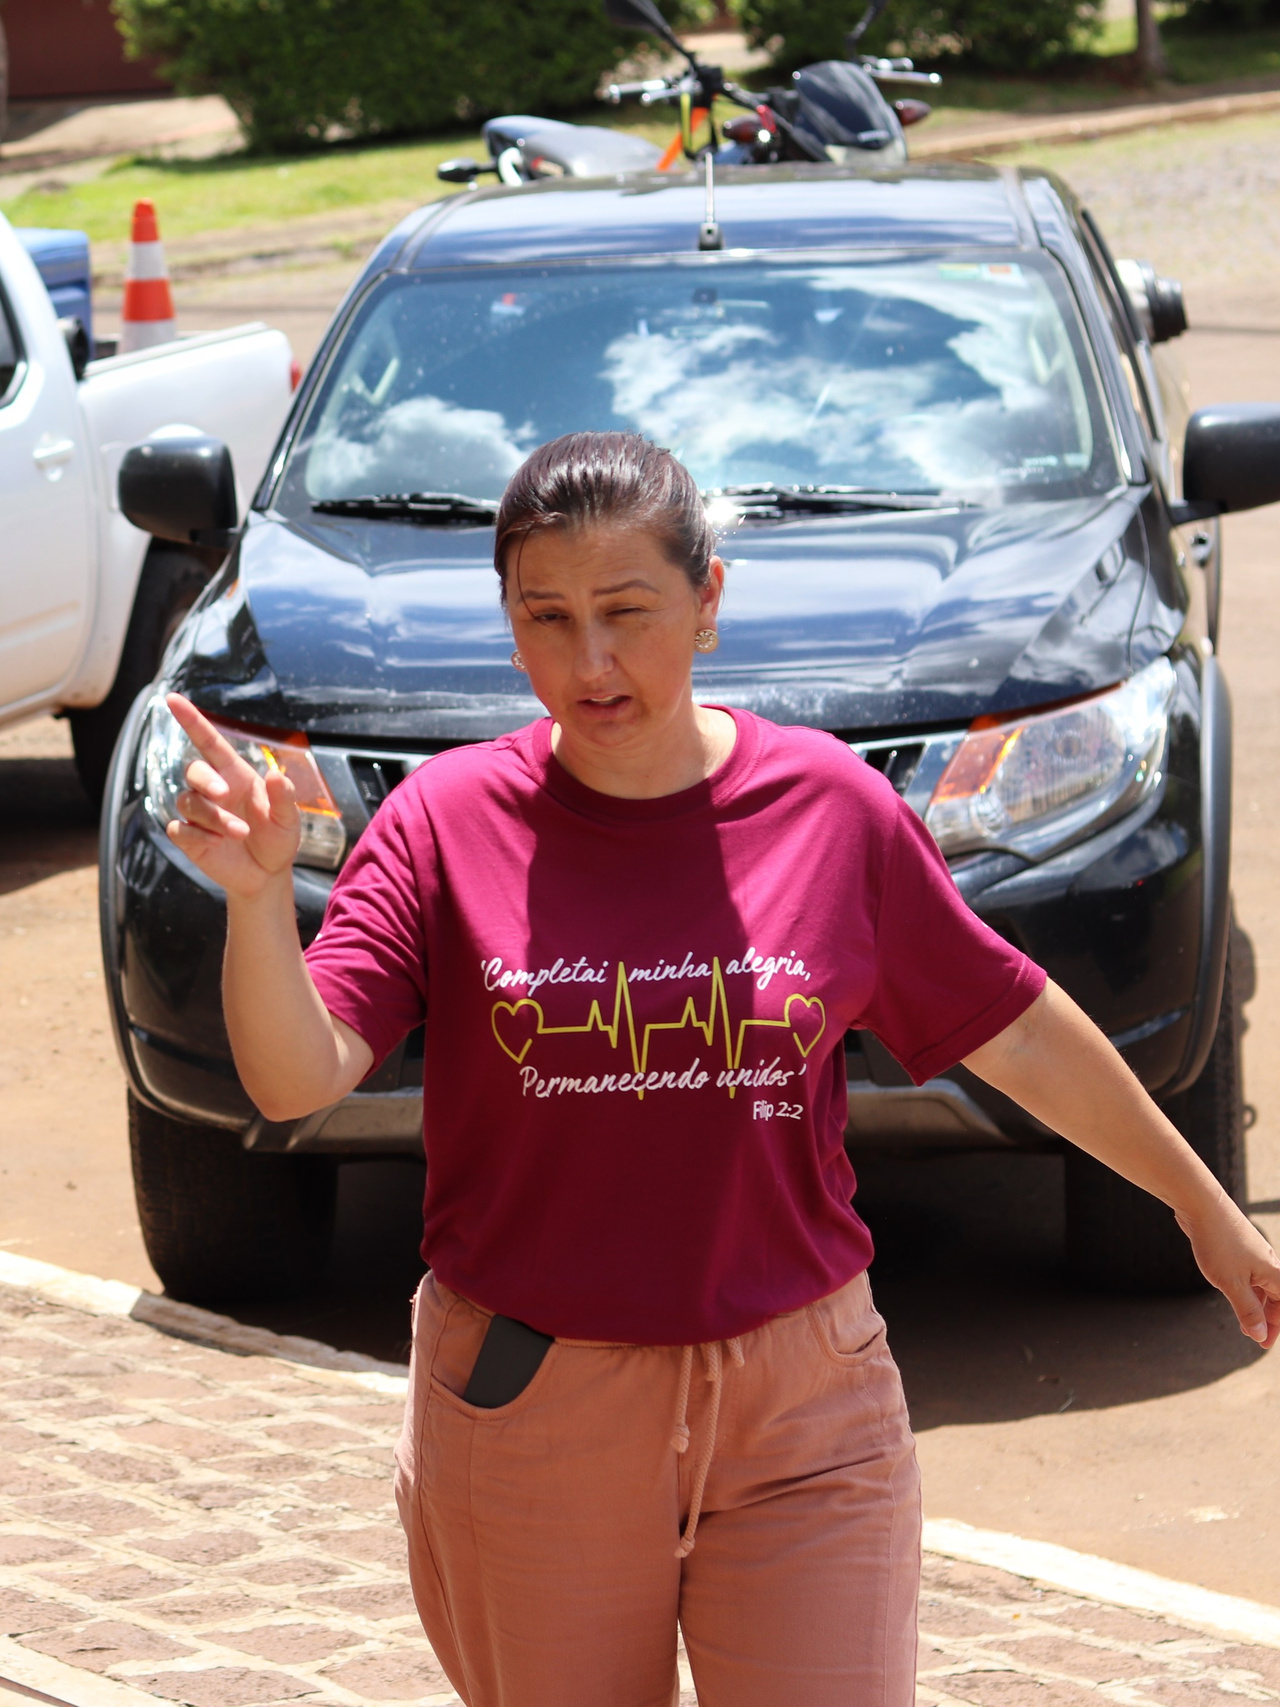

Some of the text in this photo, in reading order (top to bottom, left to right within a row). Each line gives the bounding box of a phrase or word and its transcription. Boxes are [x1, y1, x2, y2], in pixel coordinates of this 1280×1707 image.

[627, 951, 712, 983] minha
[725, 946, 812, 990] alegria,
[519, 1057, 711, 1098] Permanecendo
[775, 1101, 804, 1120] 2:2
